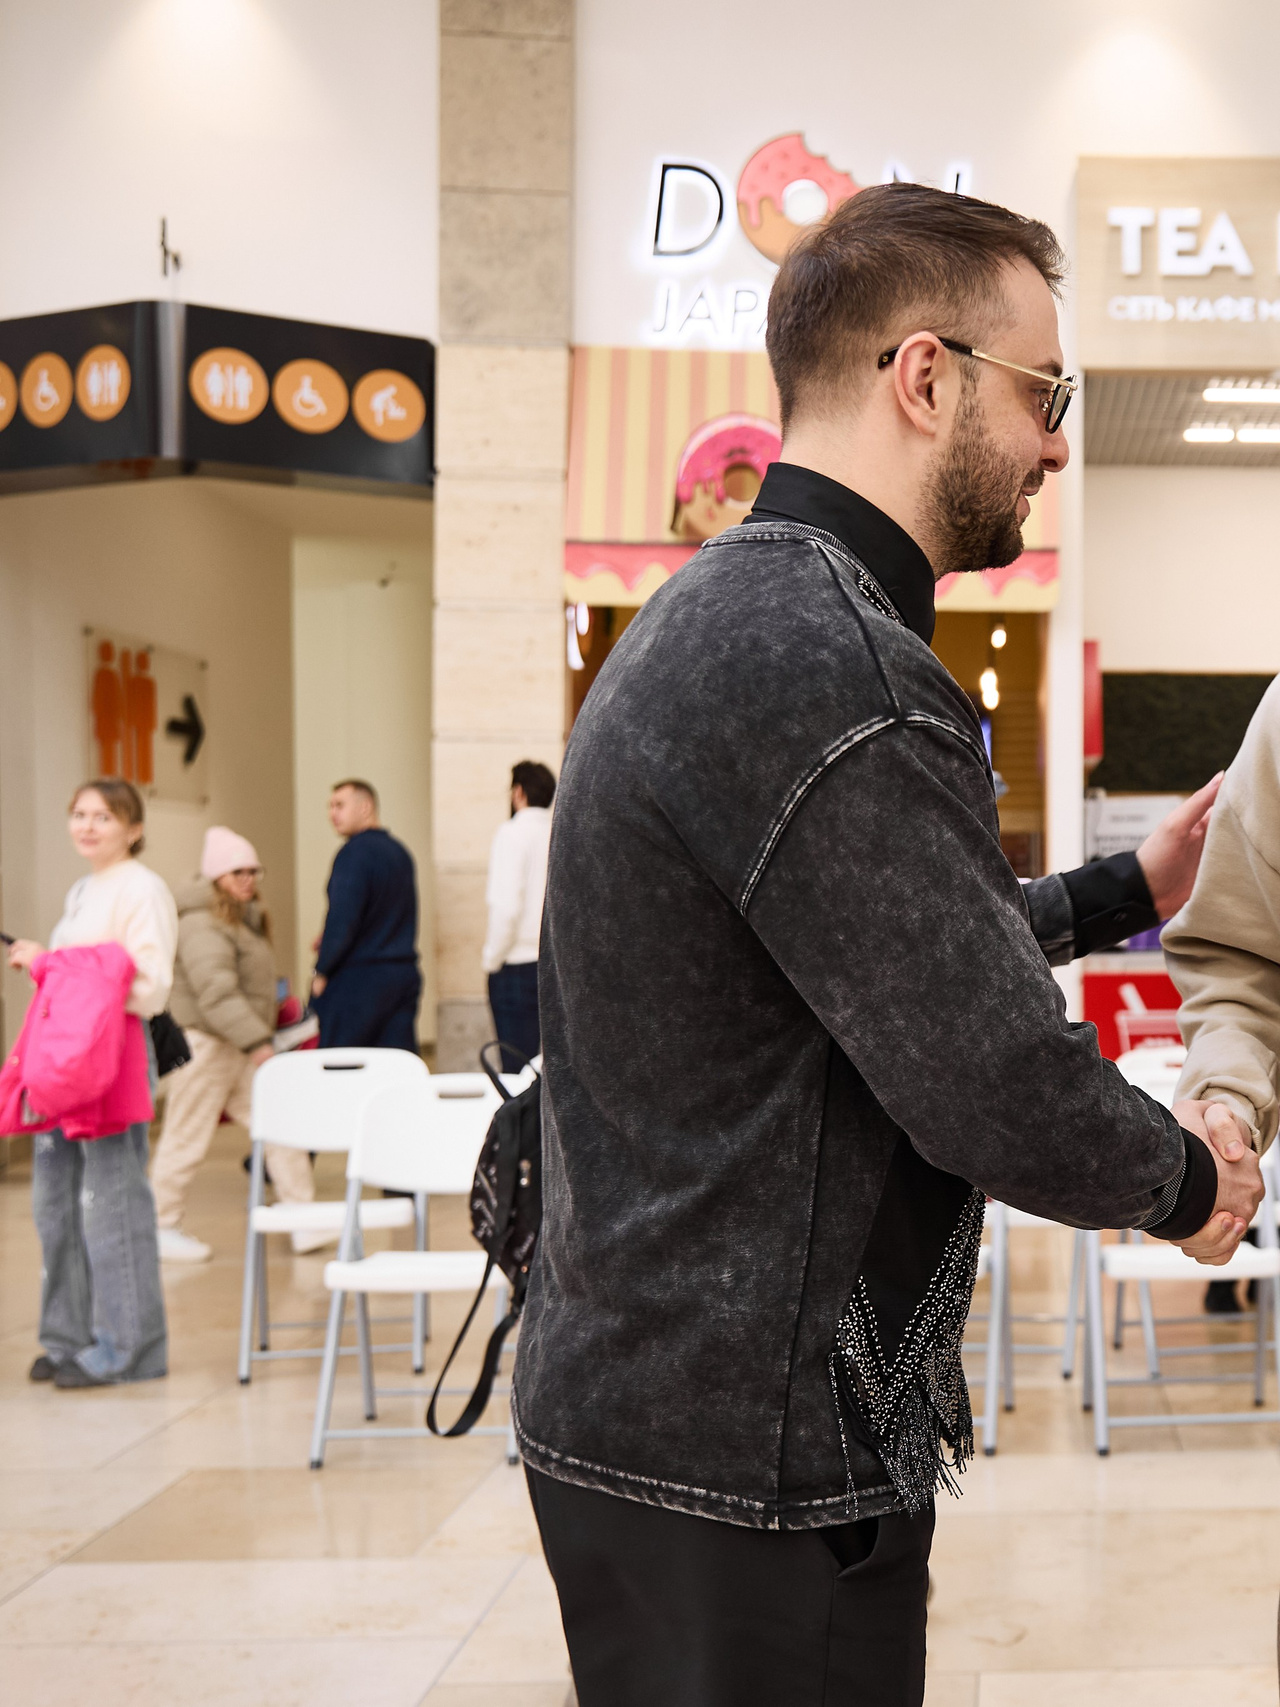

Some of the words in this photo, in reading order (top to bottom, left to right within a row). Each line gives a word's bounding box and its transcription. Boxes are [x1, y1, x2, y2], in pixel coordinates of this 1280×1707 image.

[1107, 207, 1253, 276] TEA
[1107, 296, 1174, 322] СЕТЬ
[1177, 296, 1256, 322] КАФЕ
